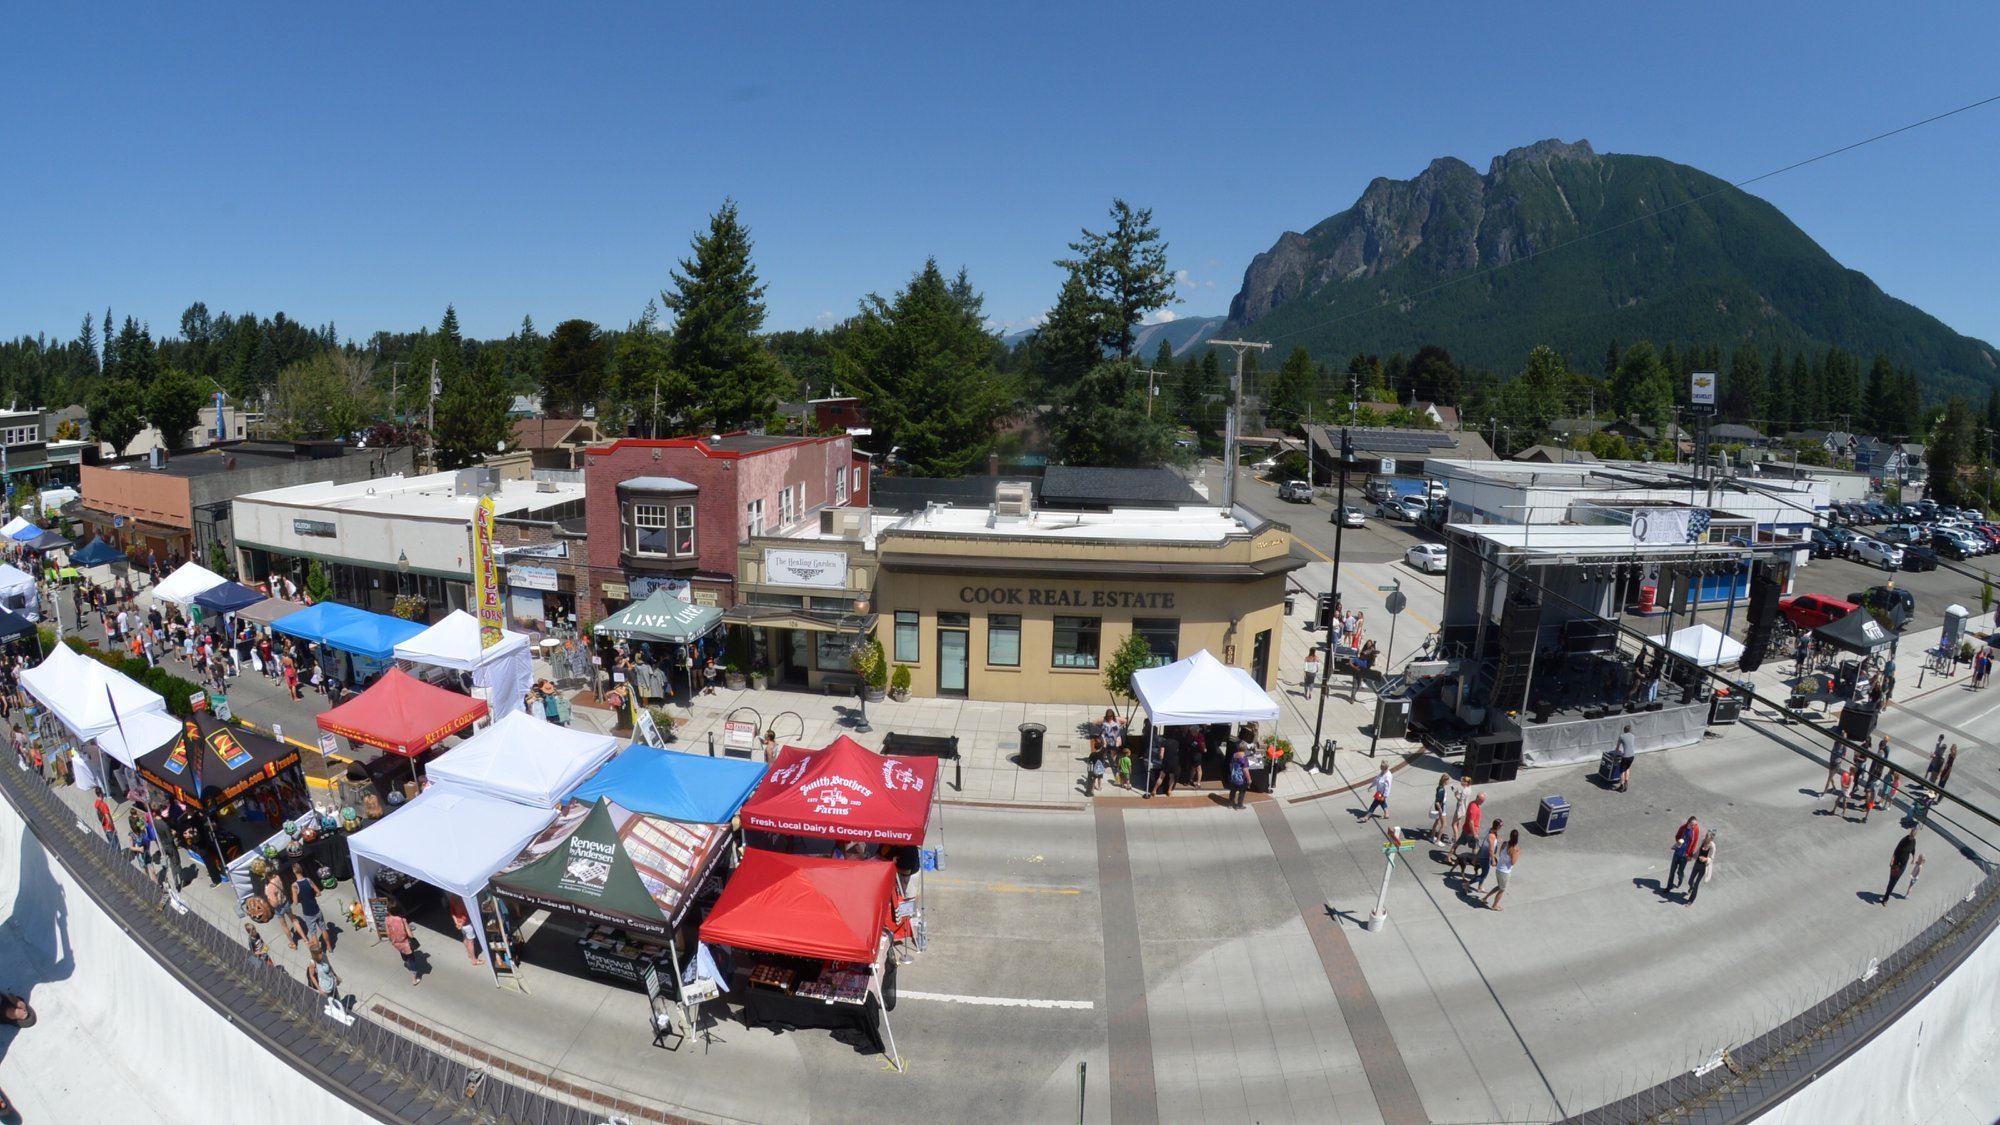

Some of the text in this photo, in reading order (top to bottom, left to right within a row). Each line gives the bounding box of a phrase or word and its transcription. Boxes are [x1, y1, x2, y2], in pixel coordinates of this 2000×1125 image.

[1632, 517, 1648, 542] Q
[478, 507, 496, 606] KETTLE
[776, 557, 836, 568] The Healing Garden
[960, 587, 1174, 609] COOK REAL ESTATE
[424, 712, 474, 744] KETTLE CORN
[800, 775, 873, 797] Smith Brothers
[814, 804, 849, 815] Farms
[778, 820, 801, 830] Local
[803, 823, 827, 834] Dairy
[837, 826, 873, 838] Grocery
[874, 829, 912, 840] Delivery
[570, 836, 616, 855] Renewal
[576, 850, 614, 863] Andersen
[526, 895, 534, 903] by
[537, 897, 571, 911] Andersen
[578, 907, 587, 915] an
[589, 910, 626, 924] Andersen
[628, 920, 664, 934] Company
[584, 950, 634, 970] Renewal
